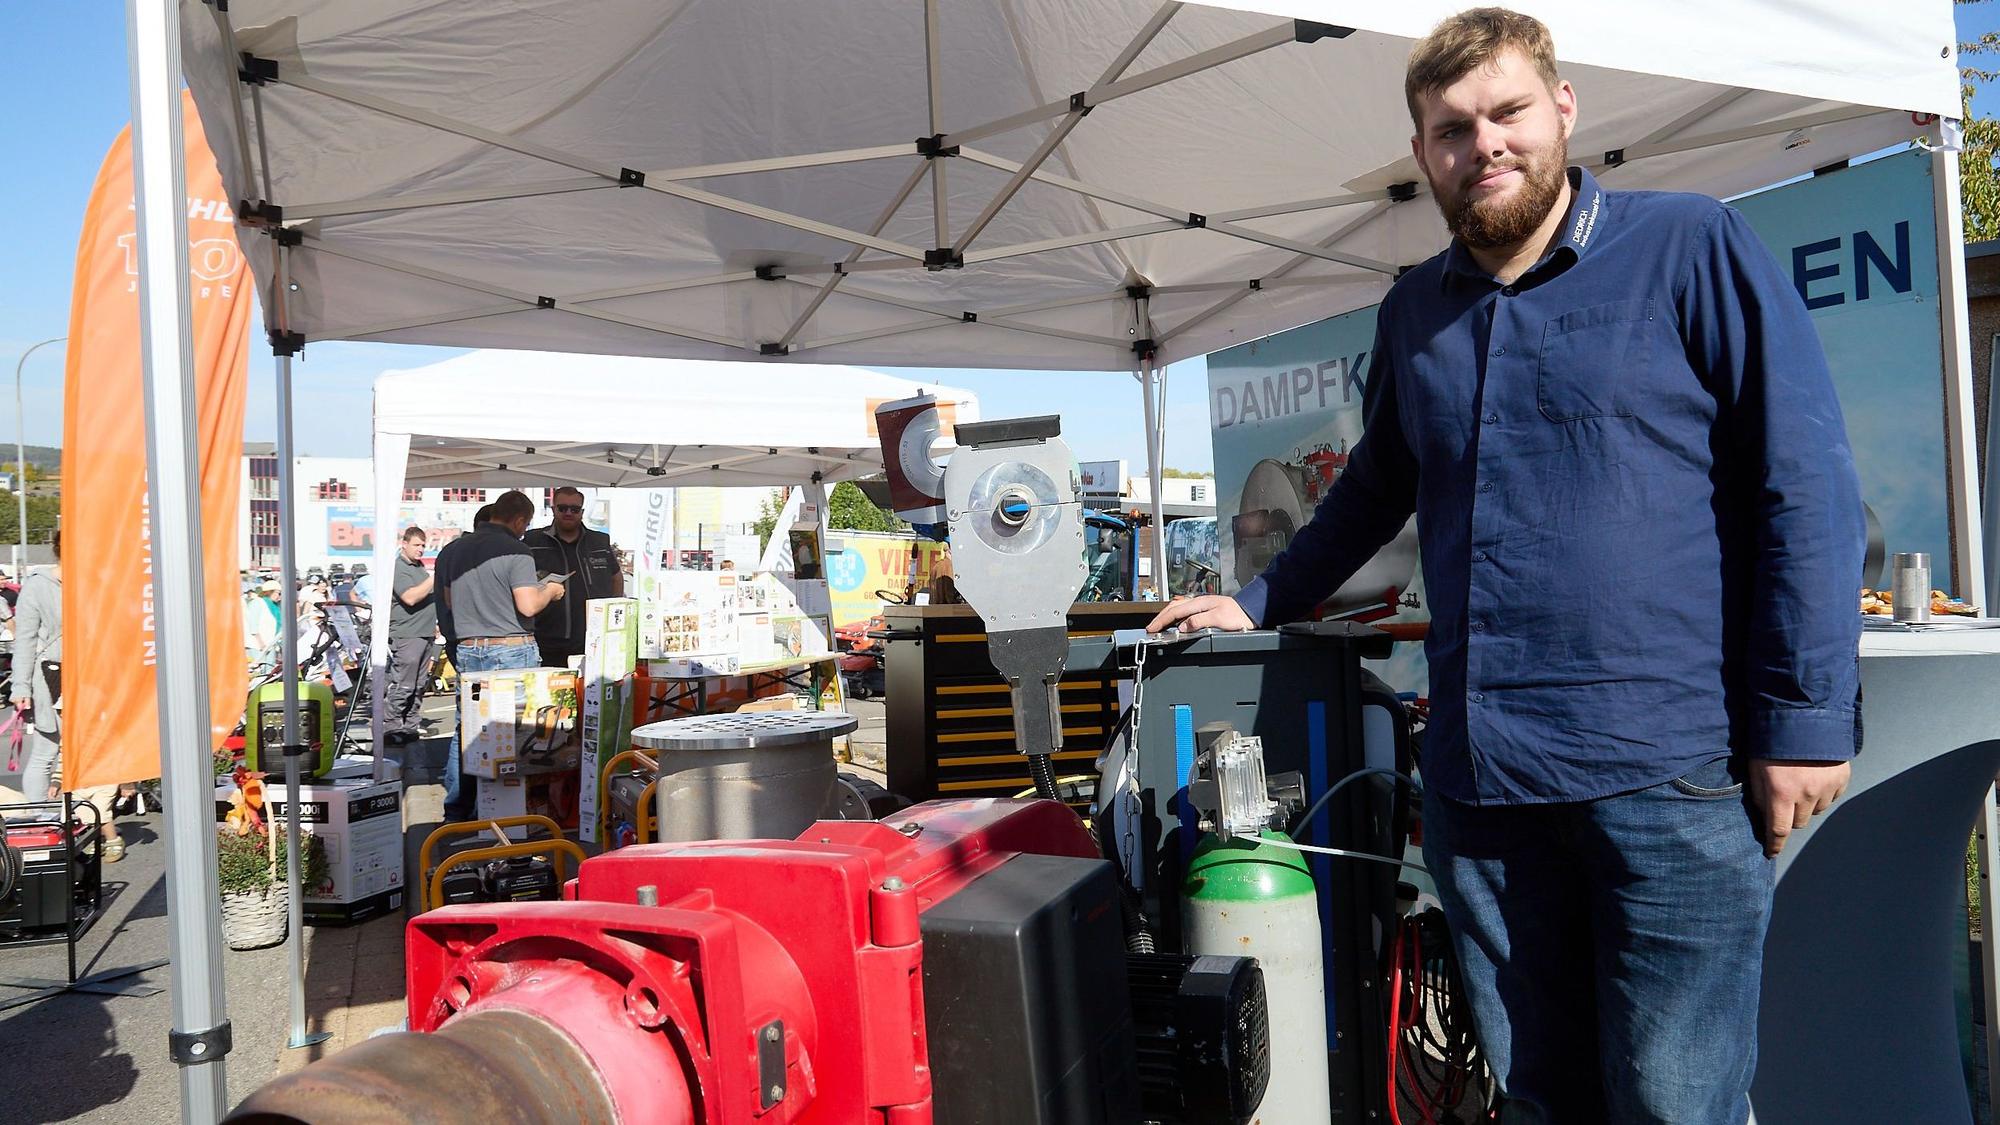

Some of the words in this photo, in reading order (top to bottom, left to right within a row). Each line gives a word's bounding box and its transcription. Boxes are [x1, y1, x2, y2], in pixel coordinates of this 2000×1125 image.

[1572, 210, 1588, 243] DIEDRICH
[1792, 220, 1912, 310] EN
[1216, 352, 1367, 429] DAMPFK
[645, 491, 663, 557] PIRIG
